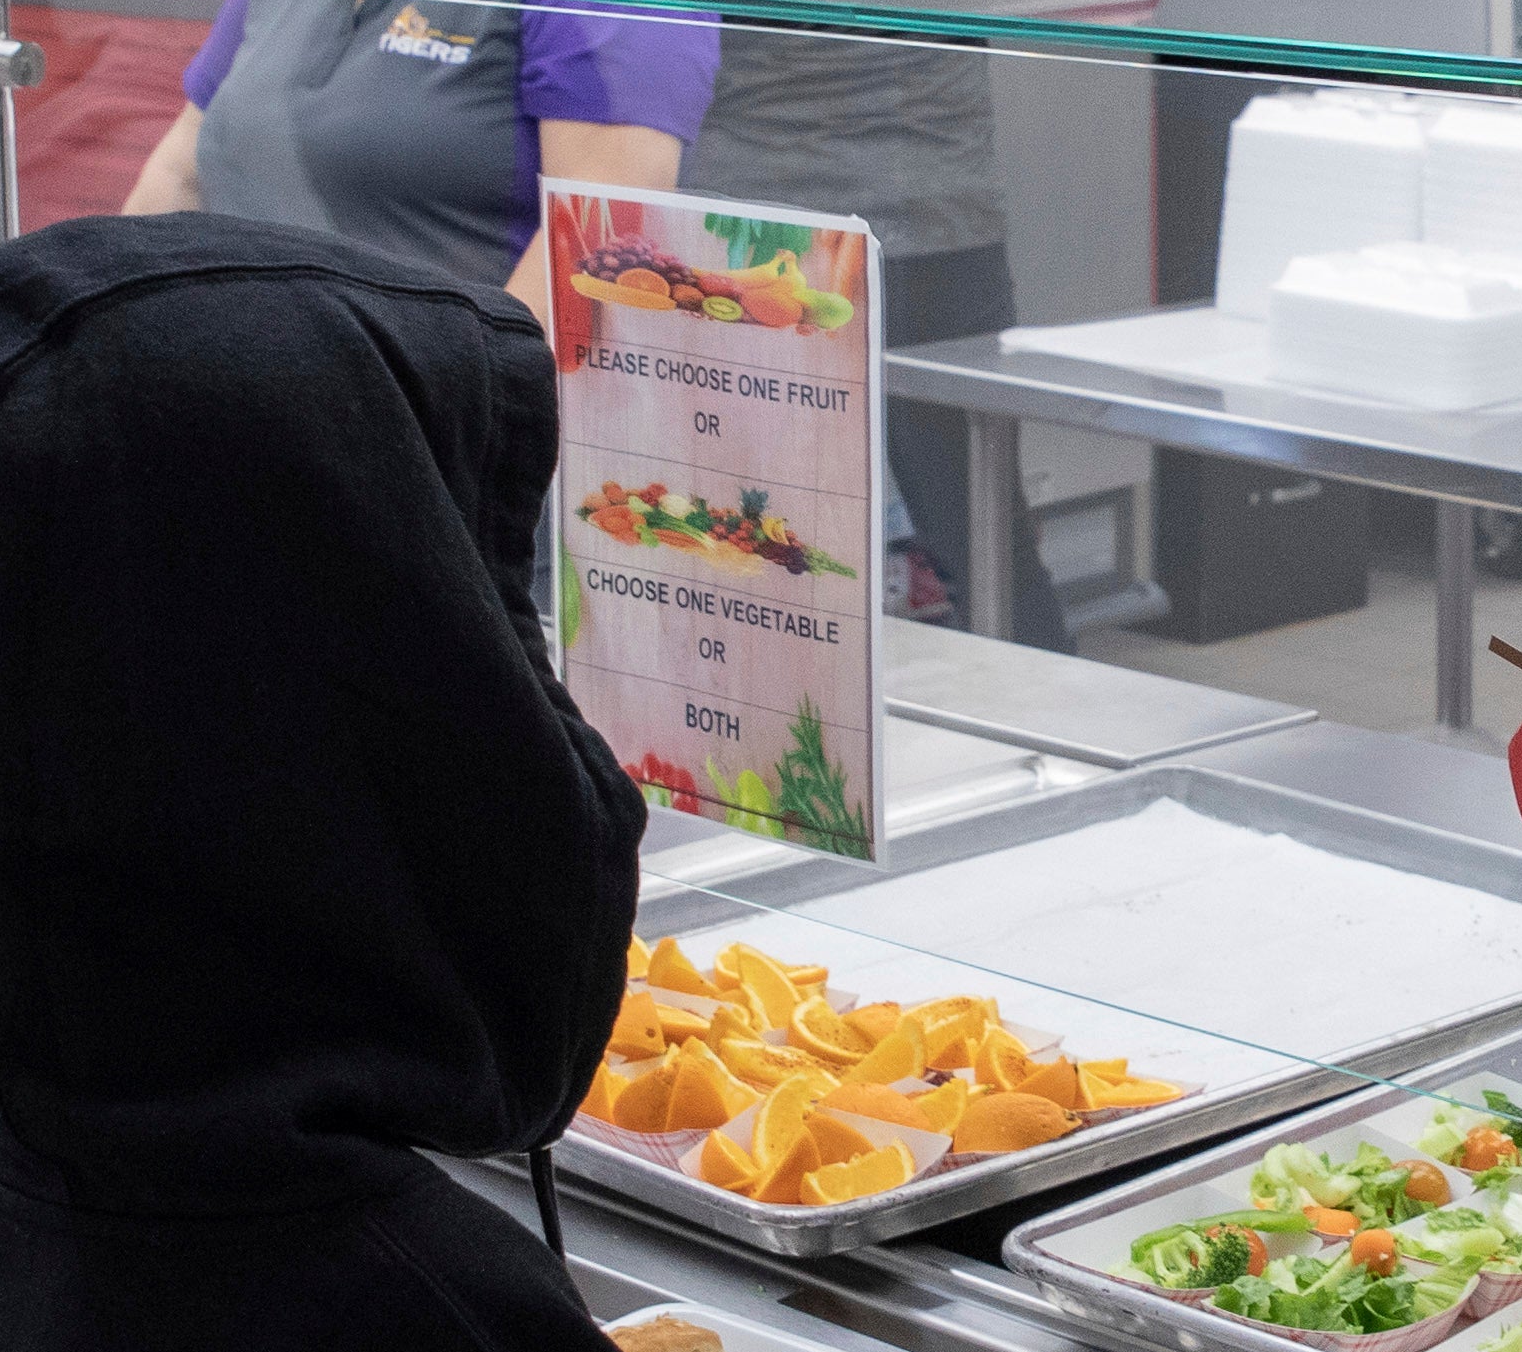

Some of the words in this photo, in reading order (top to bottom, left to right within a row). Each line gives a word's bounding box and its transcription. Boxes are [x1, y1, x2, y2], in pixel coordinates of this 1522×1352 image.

[574, 344, 649, 377] PLEASE
[654, 358, 732, 394] CHOOSE
[738, 374, 780, 402] ONE
[787, 382, 850, 412] FRUIT
[694, 411, 721, 437] OR
[586, 568, 670, 604] CHOOSE
[675, 587, 716, 616] ONE
[721, 596, 840, 644] VEGETABLE
[698, 636, 726, 663] OR
[685, 702, 740, 740] BOTH
